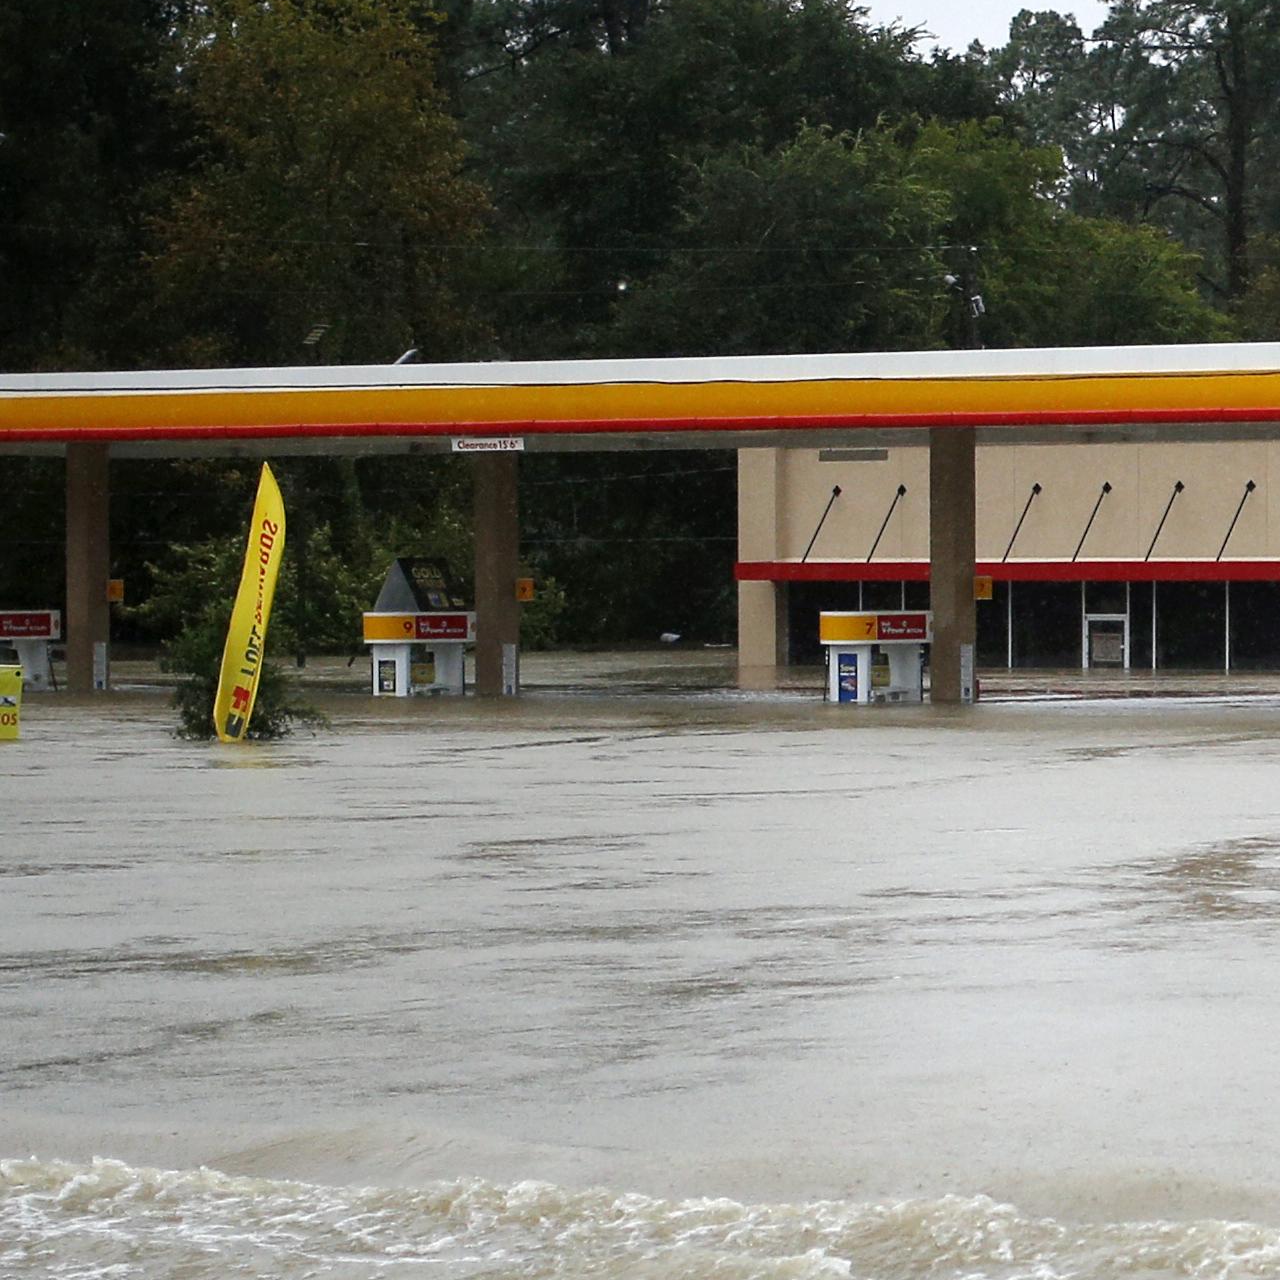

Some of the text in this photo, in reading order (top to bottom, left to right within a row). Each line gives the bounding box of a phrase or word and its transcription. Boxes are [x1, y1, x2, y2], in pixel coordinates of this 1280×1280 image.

[457, 440, 498, 449] Clearance
[403, 621, 414, 633] 9
[865, 622, 875, 634] 7
[0, 712, 17, 726] OS
